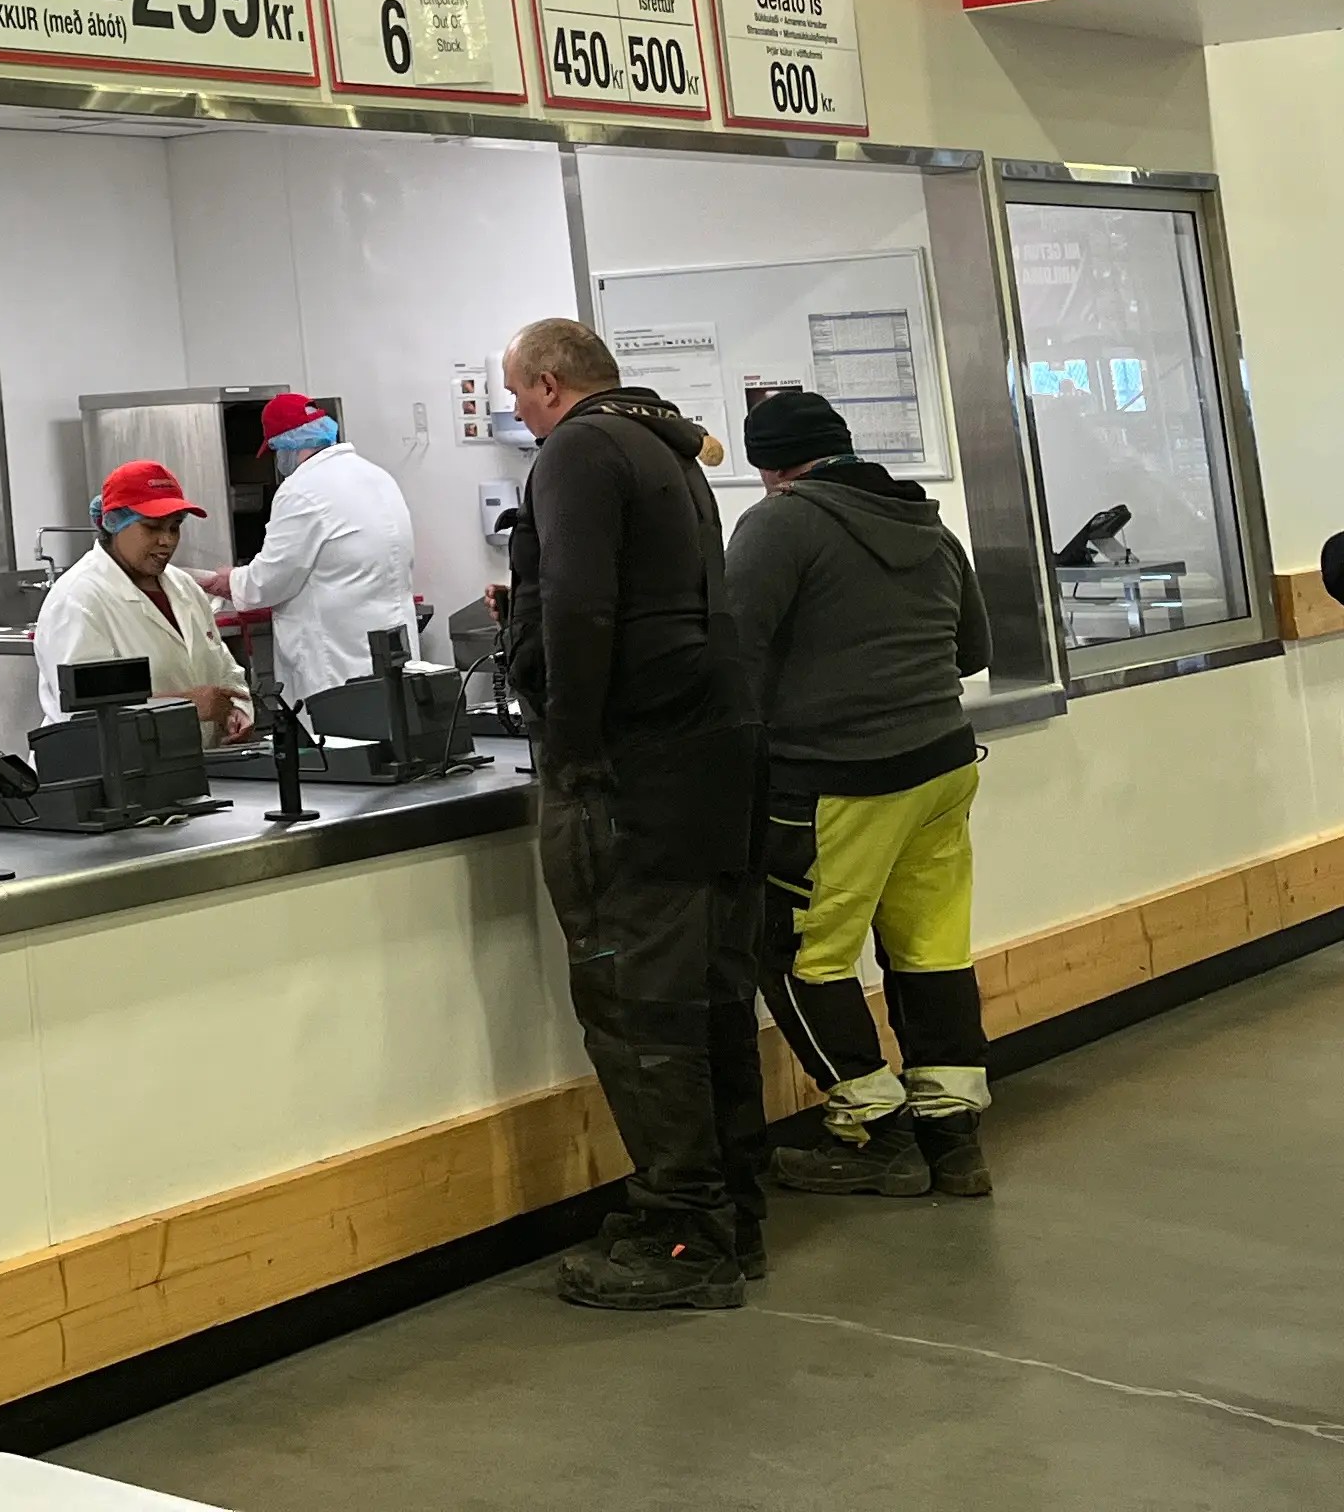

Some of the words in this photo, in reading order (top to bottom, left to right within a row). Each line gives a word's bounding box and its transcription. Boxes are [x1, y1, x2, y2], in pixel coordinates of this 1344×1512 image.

[43, 8, 83, 38] (með
[88, 12, 127, 44] ábót)
[433, 14, 448, 29] Out
